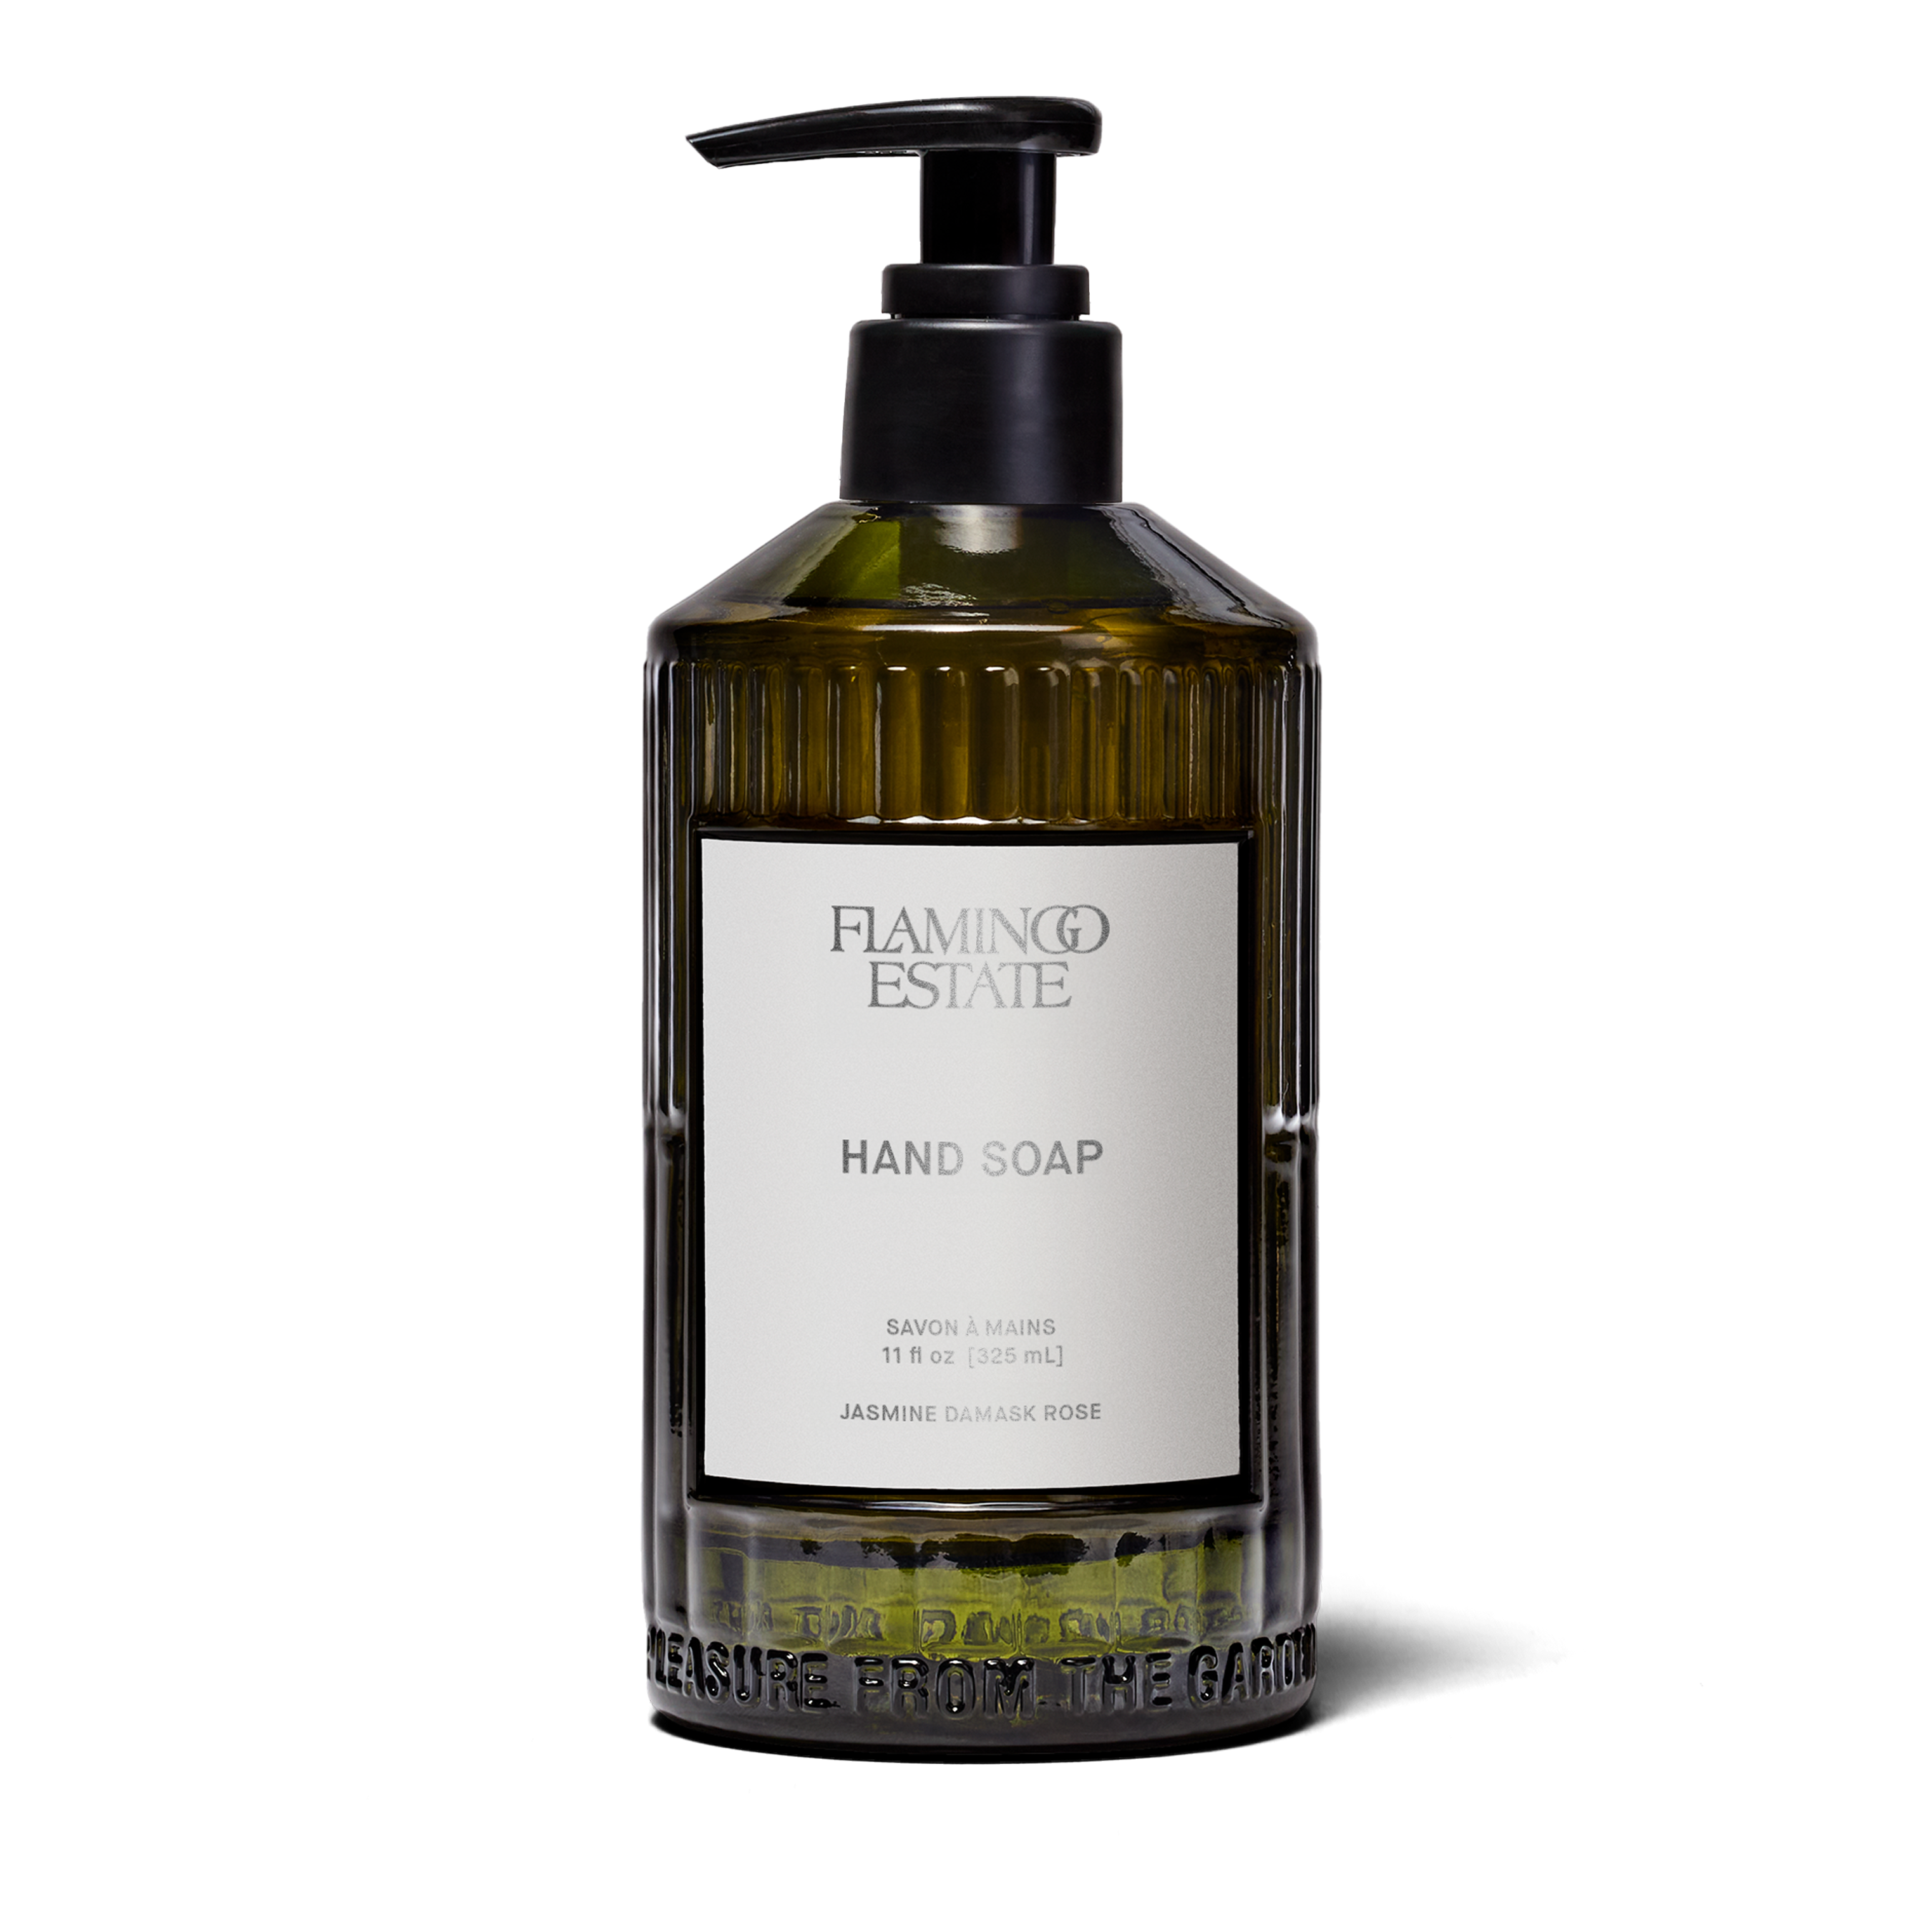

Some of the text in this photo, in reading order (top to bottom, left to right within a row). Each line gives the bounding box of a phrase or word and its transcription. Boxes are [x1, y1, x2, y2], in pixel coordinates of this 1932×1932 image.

[830, 904, 1111, 955] FLAMINGO
[867, 960, 1073, 1010] ESTATE
[841, 1139, 1103, 1177] HAND SOAP
[886, 1315, 1055, 1336] SAVON À MAINS
[882, 1345, 1063, 1369] 11 fl oz [325 mL]
[840, 1402, 1102, 1423] JASMINE DAMASK ROSE
[855, 1655, 1036, 1719] FROM
[1060, 1653, 1174, 1714] THE
